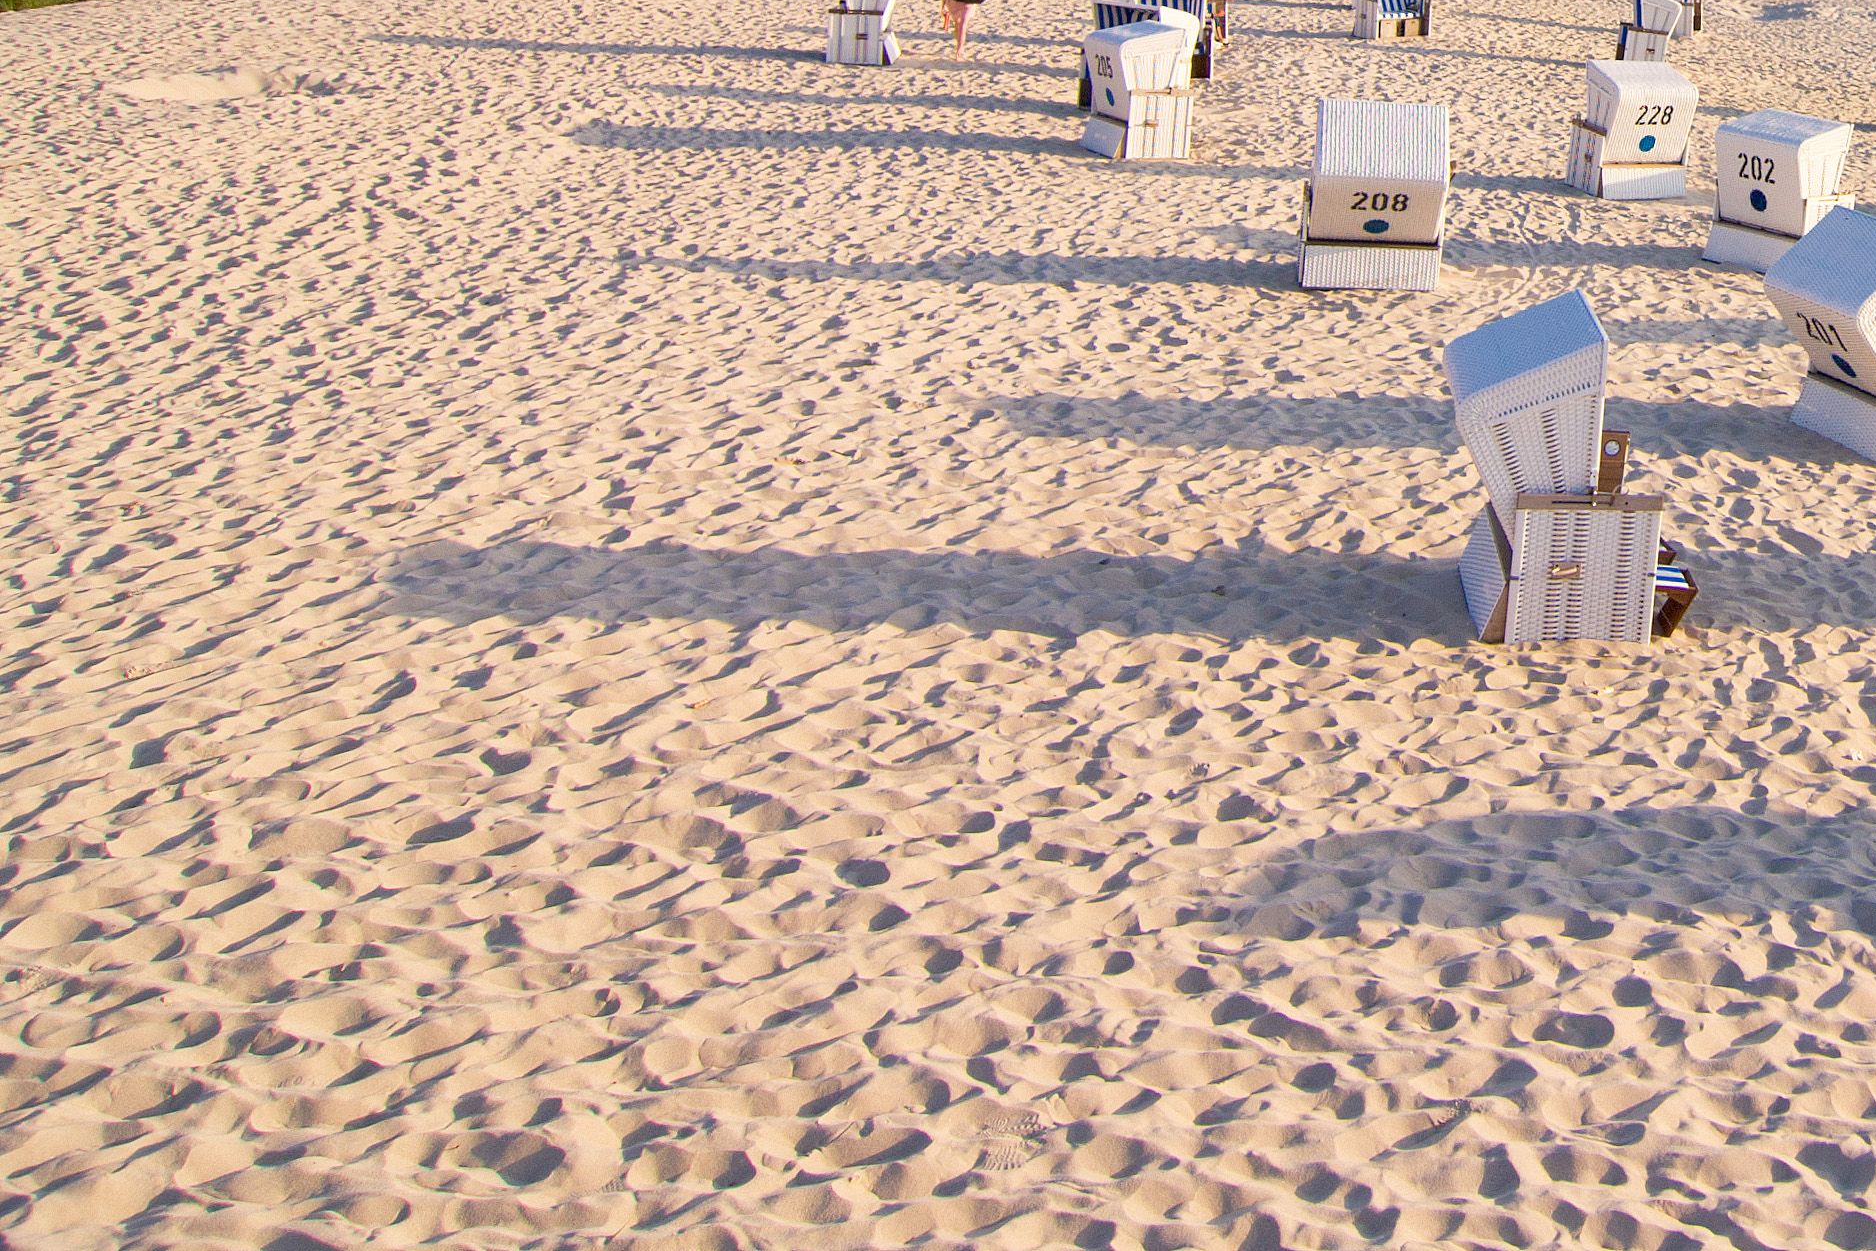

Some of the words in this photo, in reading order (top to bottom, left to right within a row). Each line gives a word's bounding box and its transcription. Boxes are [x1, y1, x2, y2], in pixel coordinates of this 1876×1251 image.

[1095, 54, 1113, 79] 205
[1635, 105, 1674, 126] 228
[1738, 152, 1776, 185] 202
[1350, 192, 1409, 212] 208
[1797, 312, 1848, 352] 201
